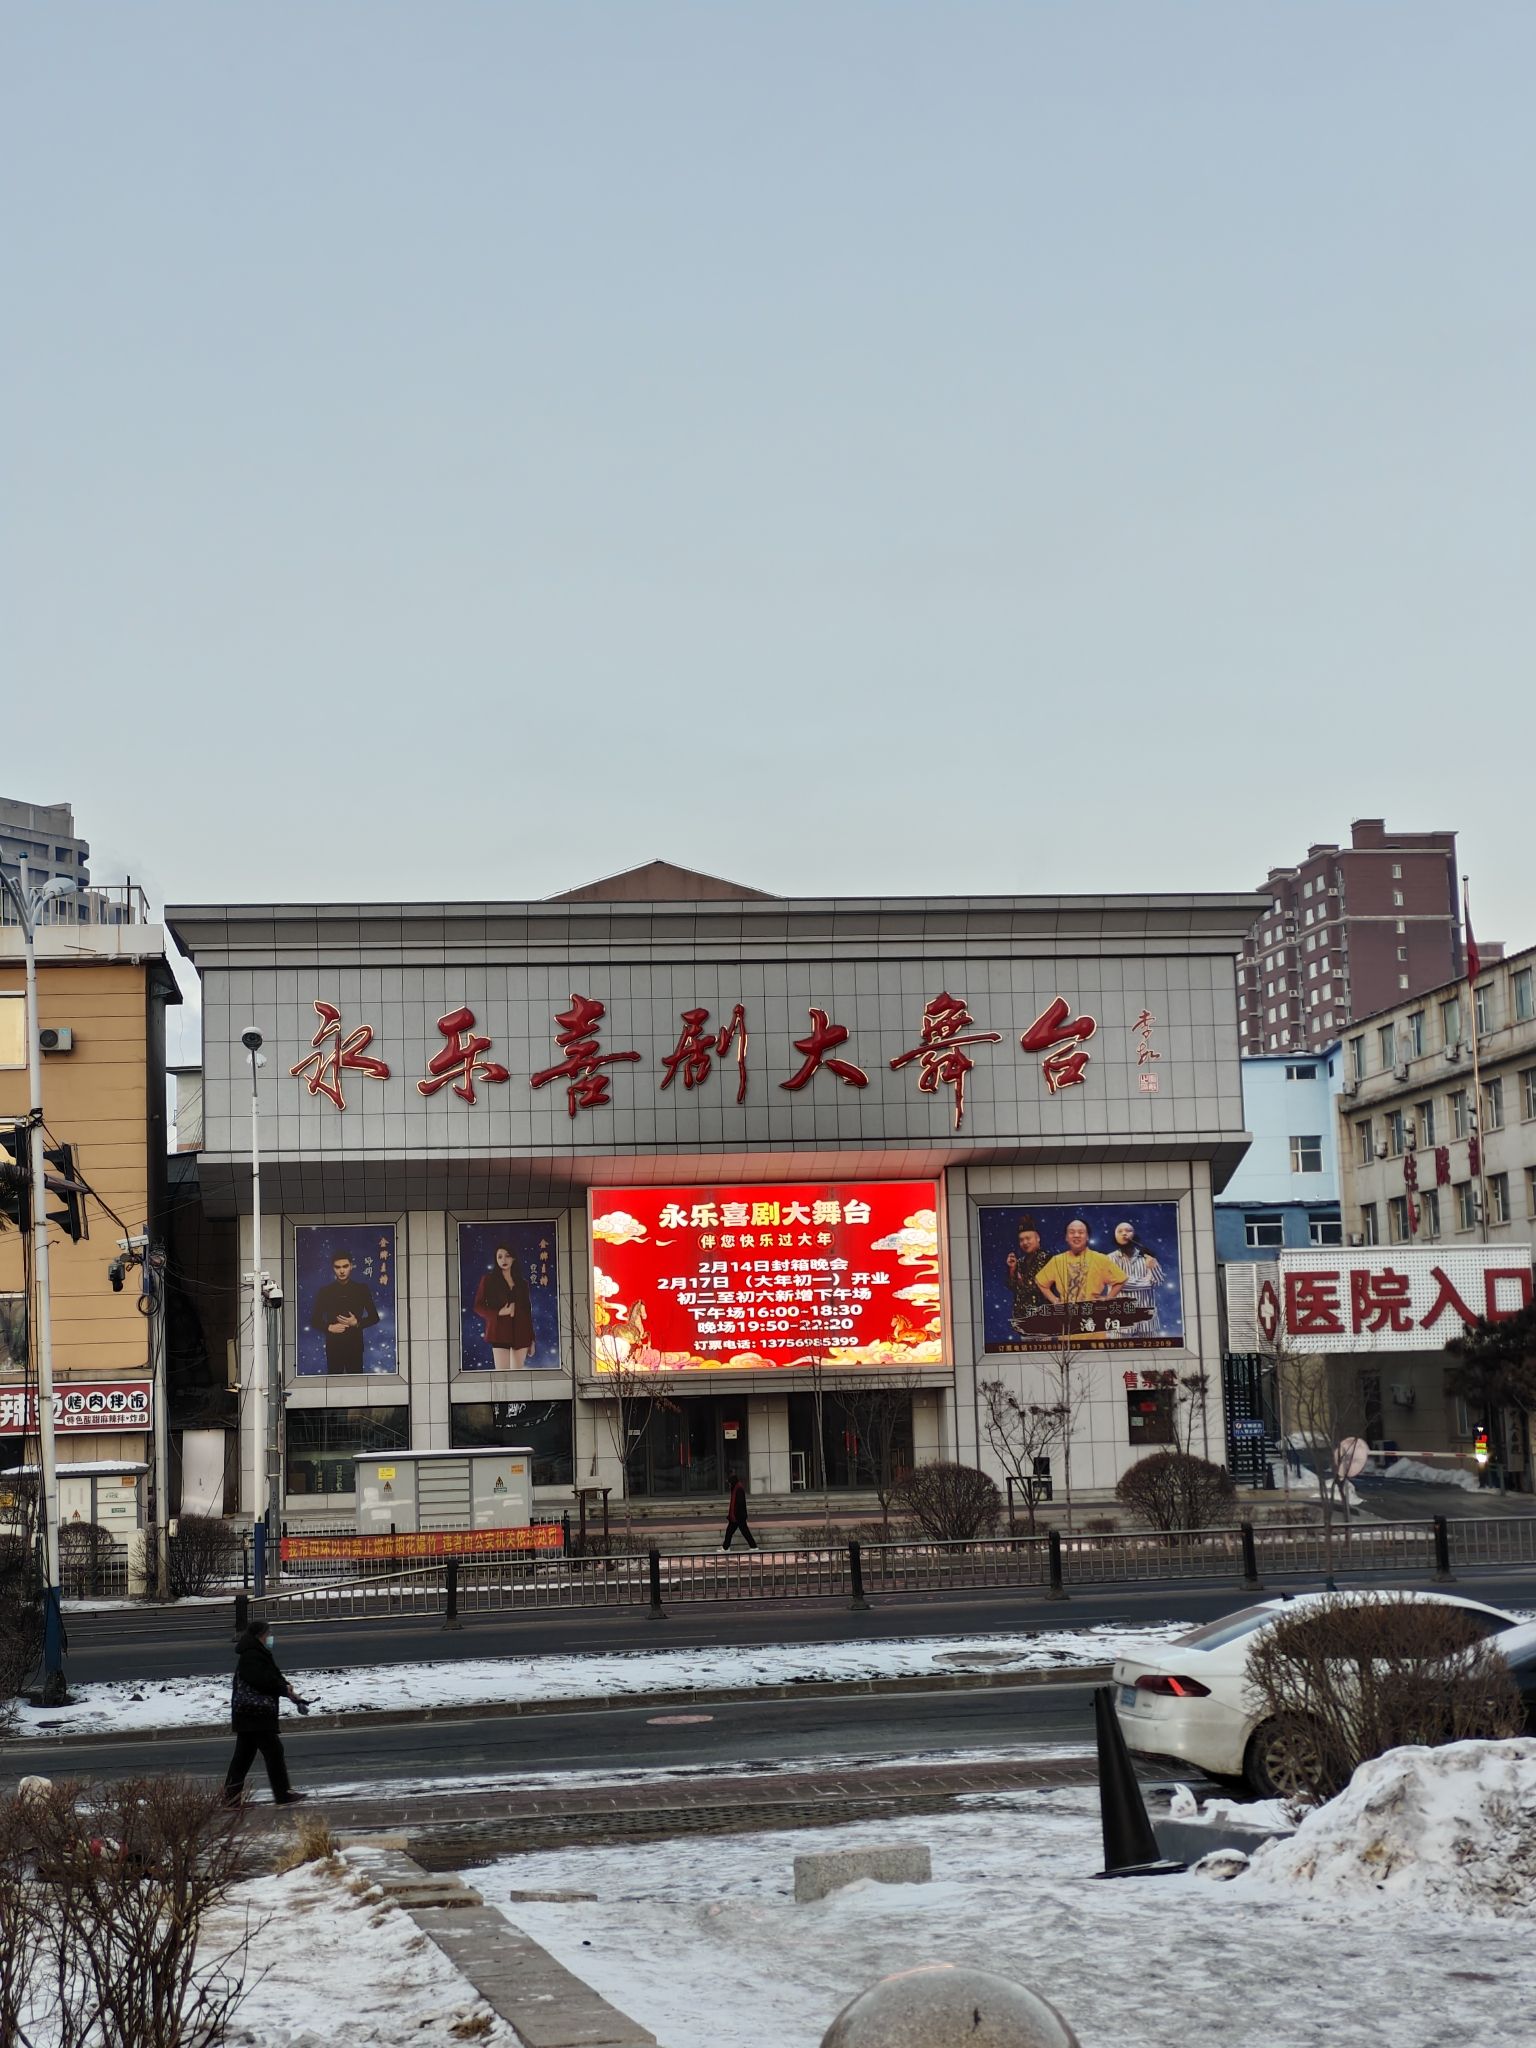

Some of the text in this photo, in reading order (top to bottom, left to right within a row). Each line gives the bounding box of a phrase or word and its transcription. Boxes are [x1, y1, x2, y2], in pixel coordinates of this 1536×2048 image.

[658, 1199, 872, 1229] 永乐喜剧大舞台
[701, 1231, 832, 1250] 伴您快乐过大年
[698, 1258, 849, 1274] 2月14日封箱晚会
[677, 1287, 872, 1305] 初二至初六新增下午场
[1284, 1266, 1534, 1335] 医院入口
[688, 1304, 863, 1320] 下午场16:00-18:30
[697, 1318, 854, 1334] 晚场19:50-22:20
[67, 1394, 145, 1410] 烤肉拌饭
[288, 1528, 557, 1559] 我市四环以内禁止燃放烟花爆竹 违者由公安机关依法处罚
